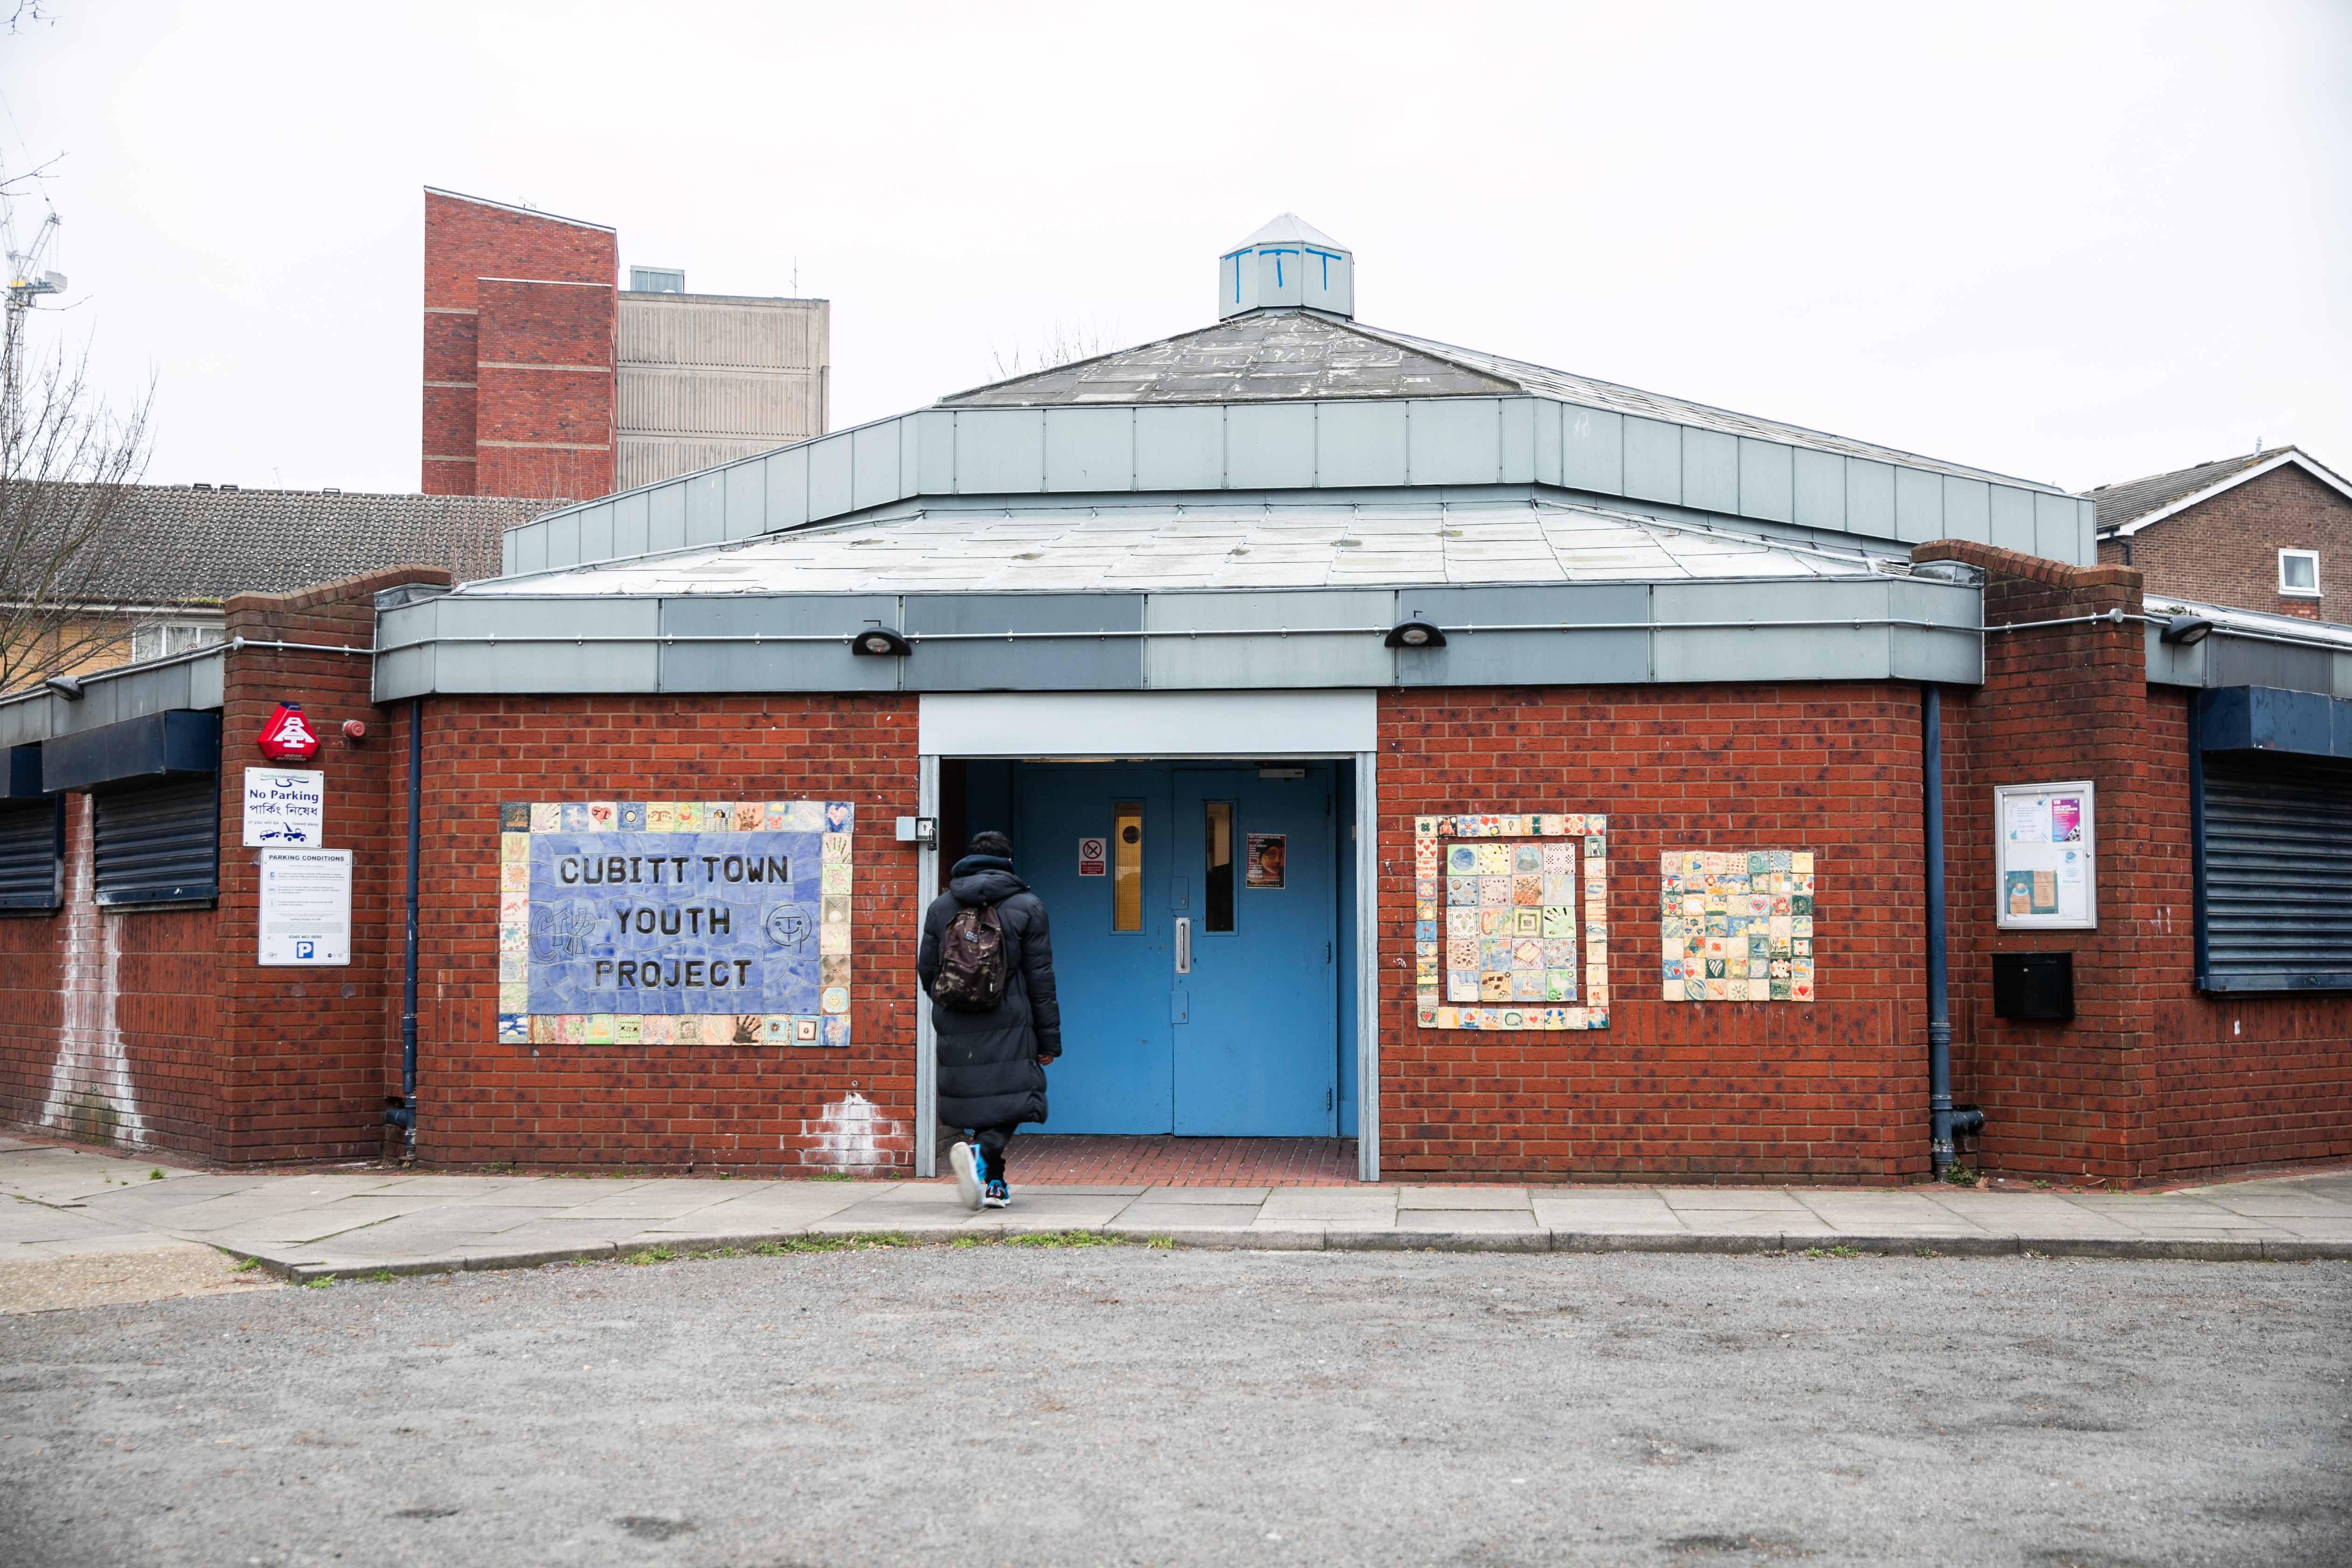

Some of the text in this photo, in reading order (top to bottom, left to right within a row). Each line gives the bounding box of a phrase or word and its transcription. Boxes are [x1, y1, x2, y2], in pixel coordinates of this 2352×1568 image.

[250, 789, 319, 804] No Parking
[285, 803, 318, 816] নিষেধ
[560, 855, 788, 884] CUBITT TOWN
[616, 907, 730, 935] YOUTH
[1770, 938, 1789, 952] River
[595, 959, 752, 987] PROJECT
